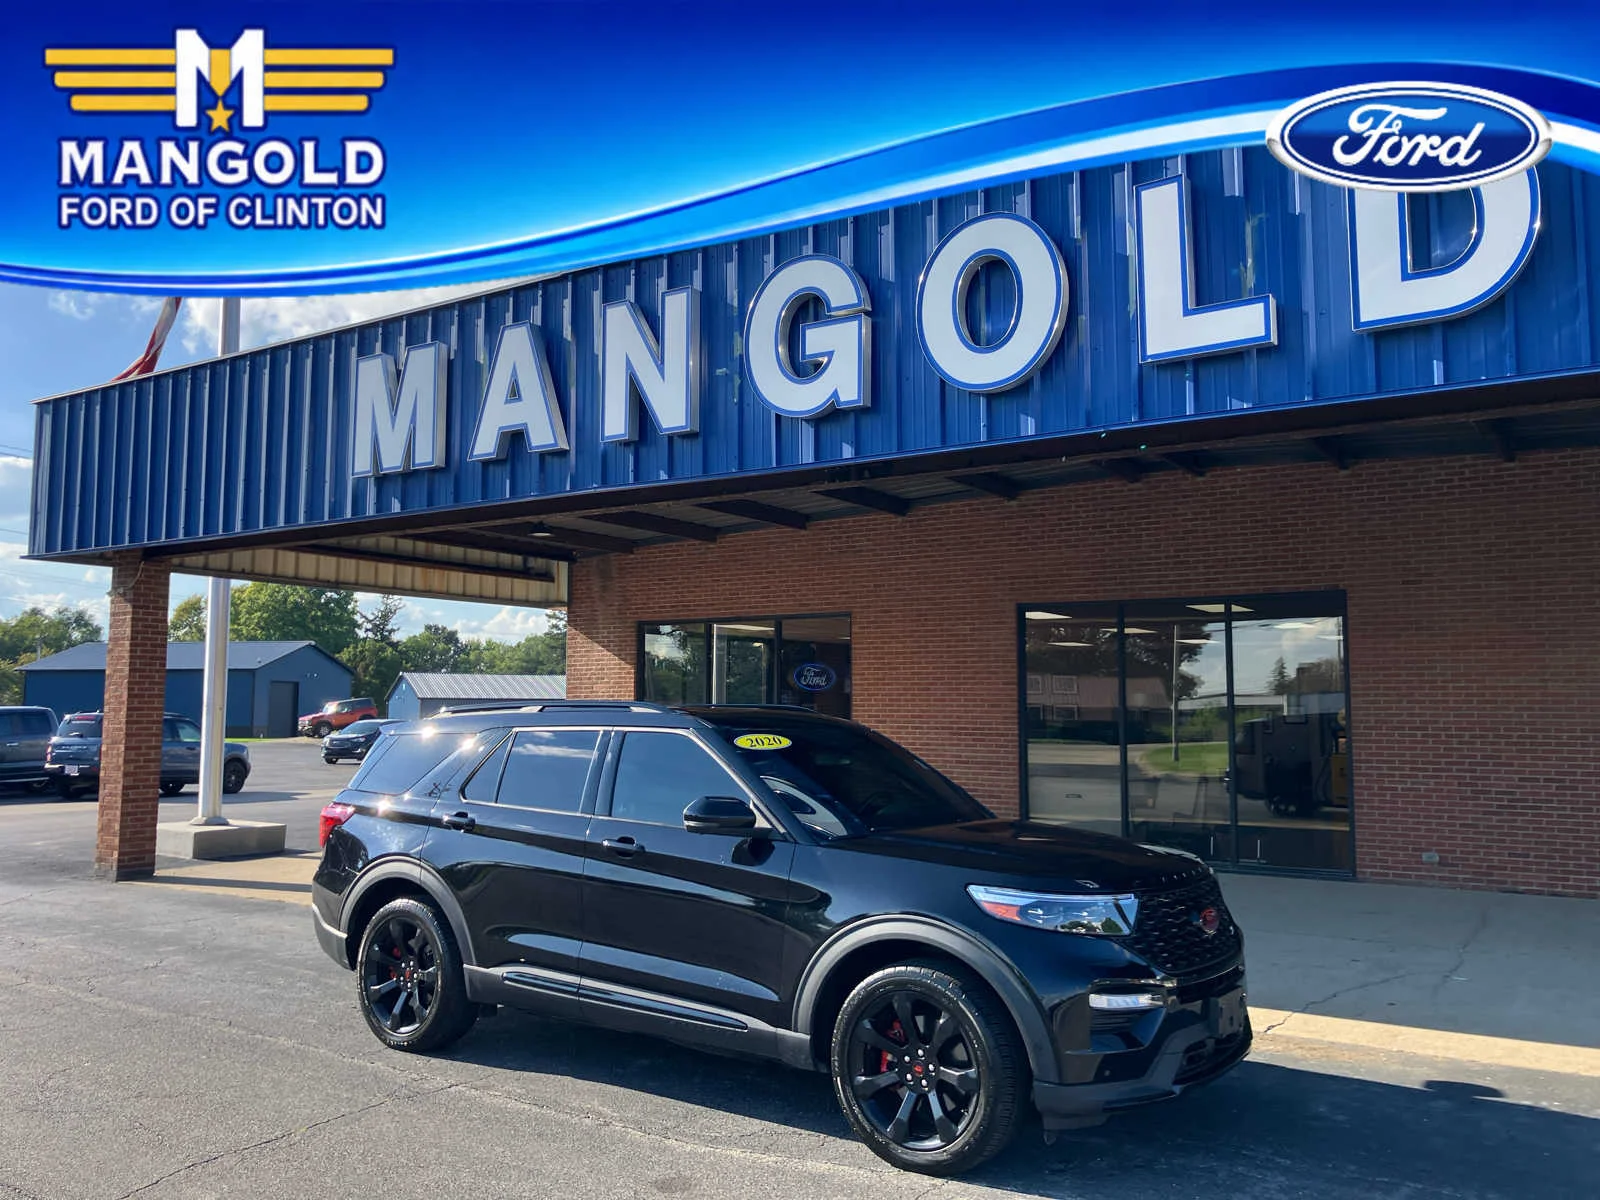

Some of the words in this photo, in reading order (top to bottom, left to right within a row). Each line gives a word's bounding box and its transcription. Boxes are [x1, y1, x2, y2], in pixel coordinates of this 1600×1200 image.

[352, 164, 1541, 478] MANGOLD
[801, 667, 827, 686] Ford
[746, 737, 782, 747] 2020
